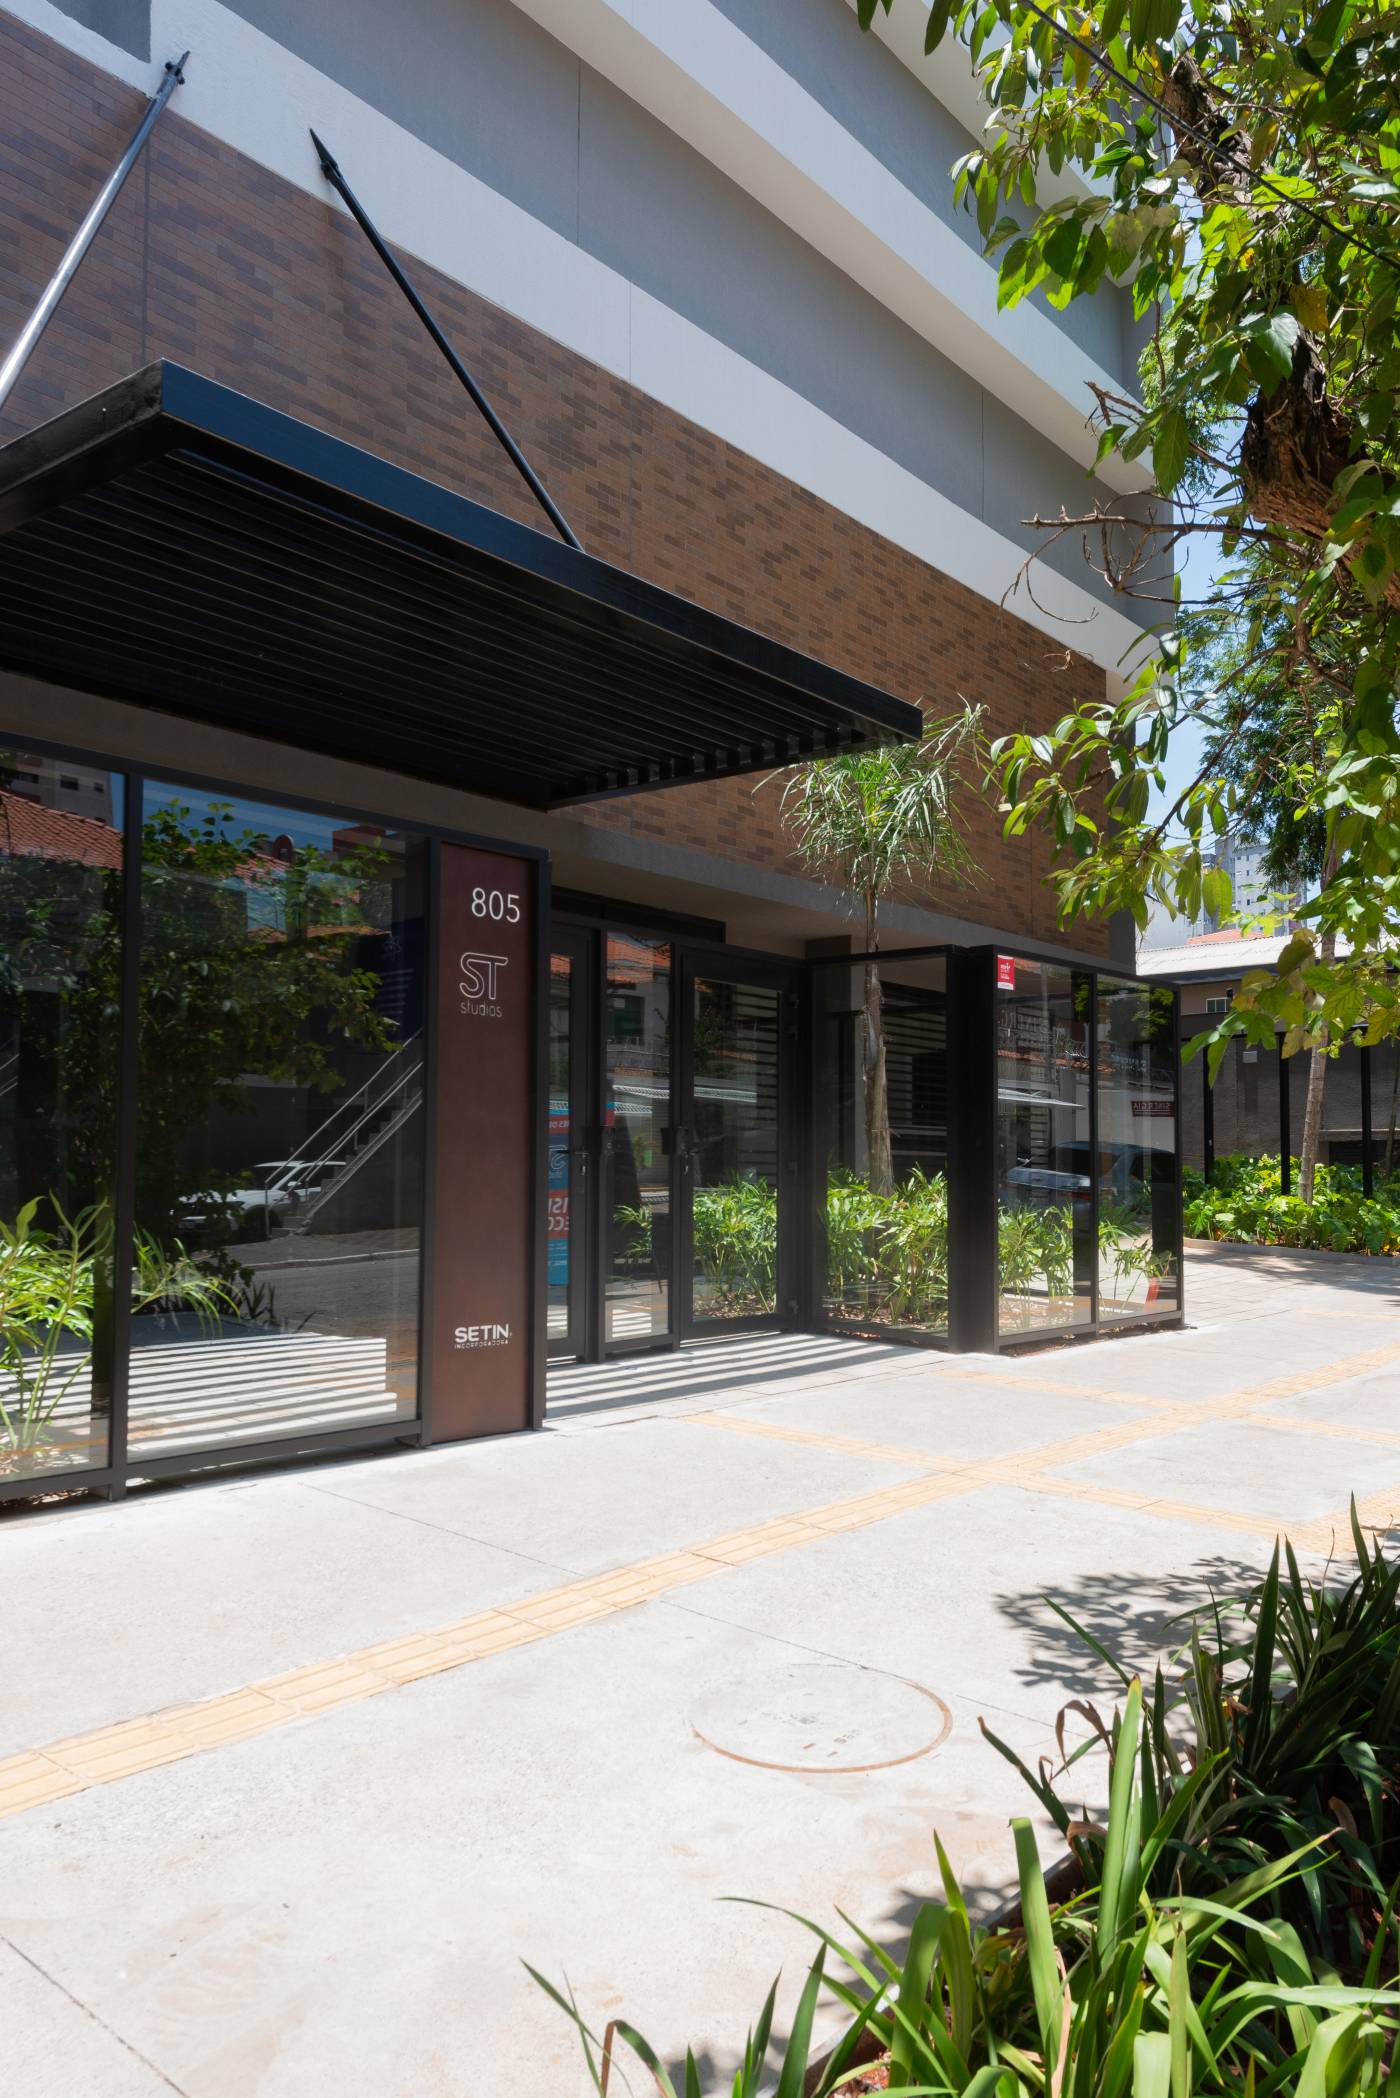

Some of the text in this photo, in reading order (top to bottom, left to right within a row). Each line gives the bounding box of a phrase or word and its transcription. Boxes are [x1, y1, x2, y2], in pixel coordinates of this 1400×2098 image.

[471, 887, 520, 923] 805
[459, 951, 509, 1000] ST
[460, 1000, 503, 1018] studios
[454, 1323, 510, 1343] SETIN
